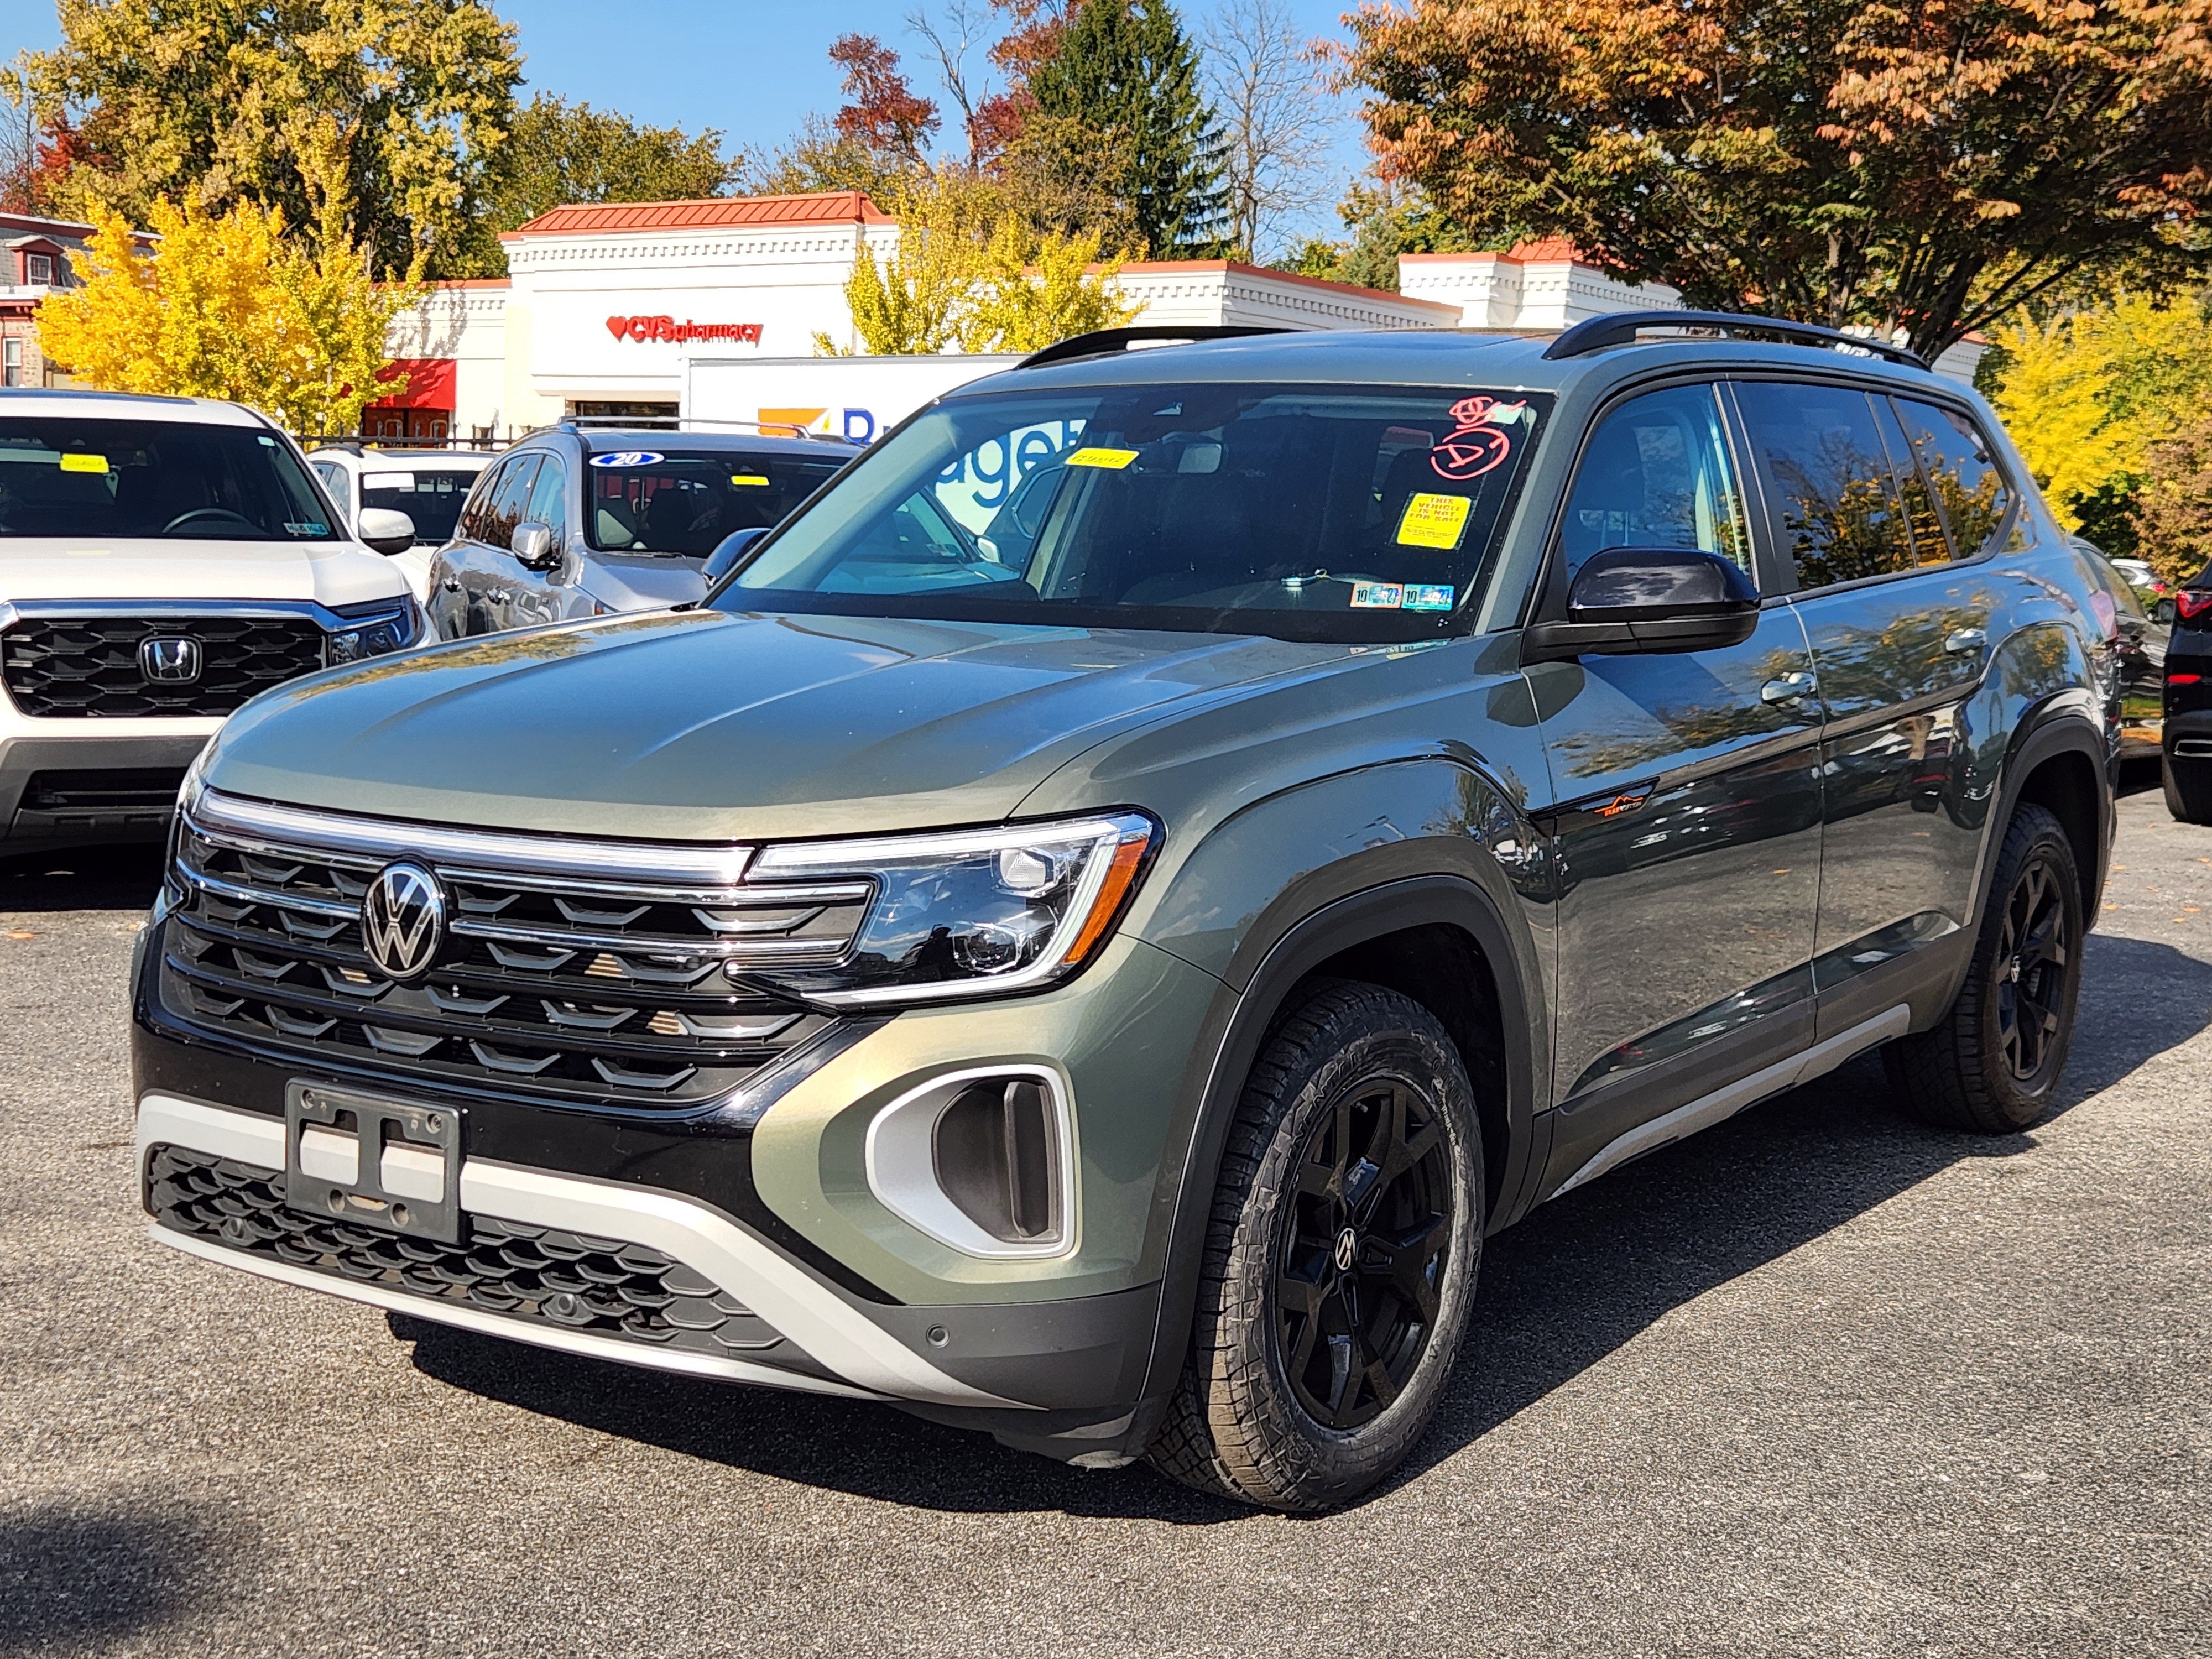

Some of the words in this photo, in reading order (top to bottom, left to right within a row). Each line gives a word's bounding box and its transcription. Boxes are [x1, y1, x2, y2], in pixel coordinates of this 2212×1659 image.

[608, 452, 642, 465] 20
[1418, 503, 1460, 511] VEHICLE
[1357, 589, 1368, 602] 10
[1406, 591, 1417, 603] 10
